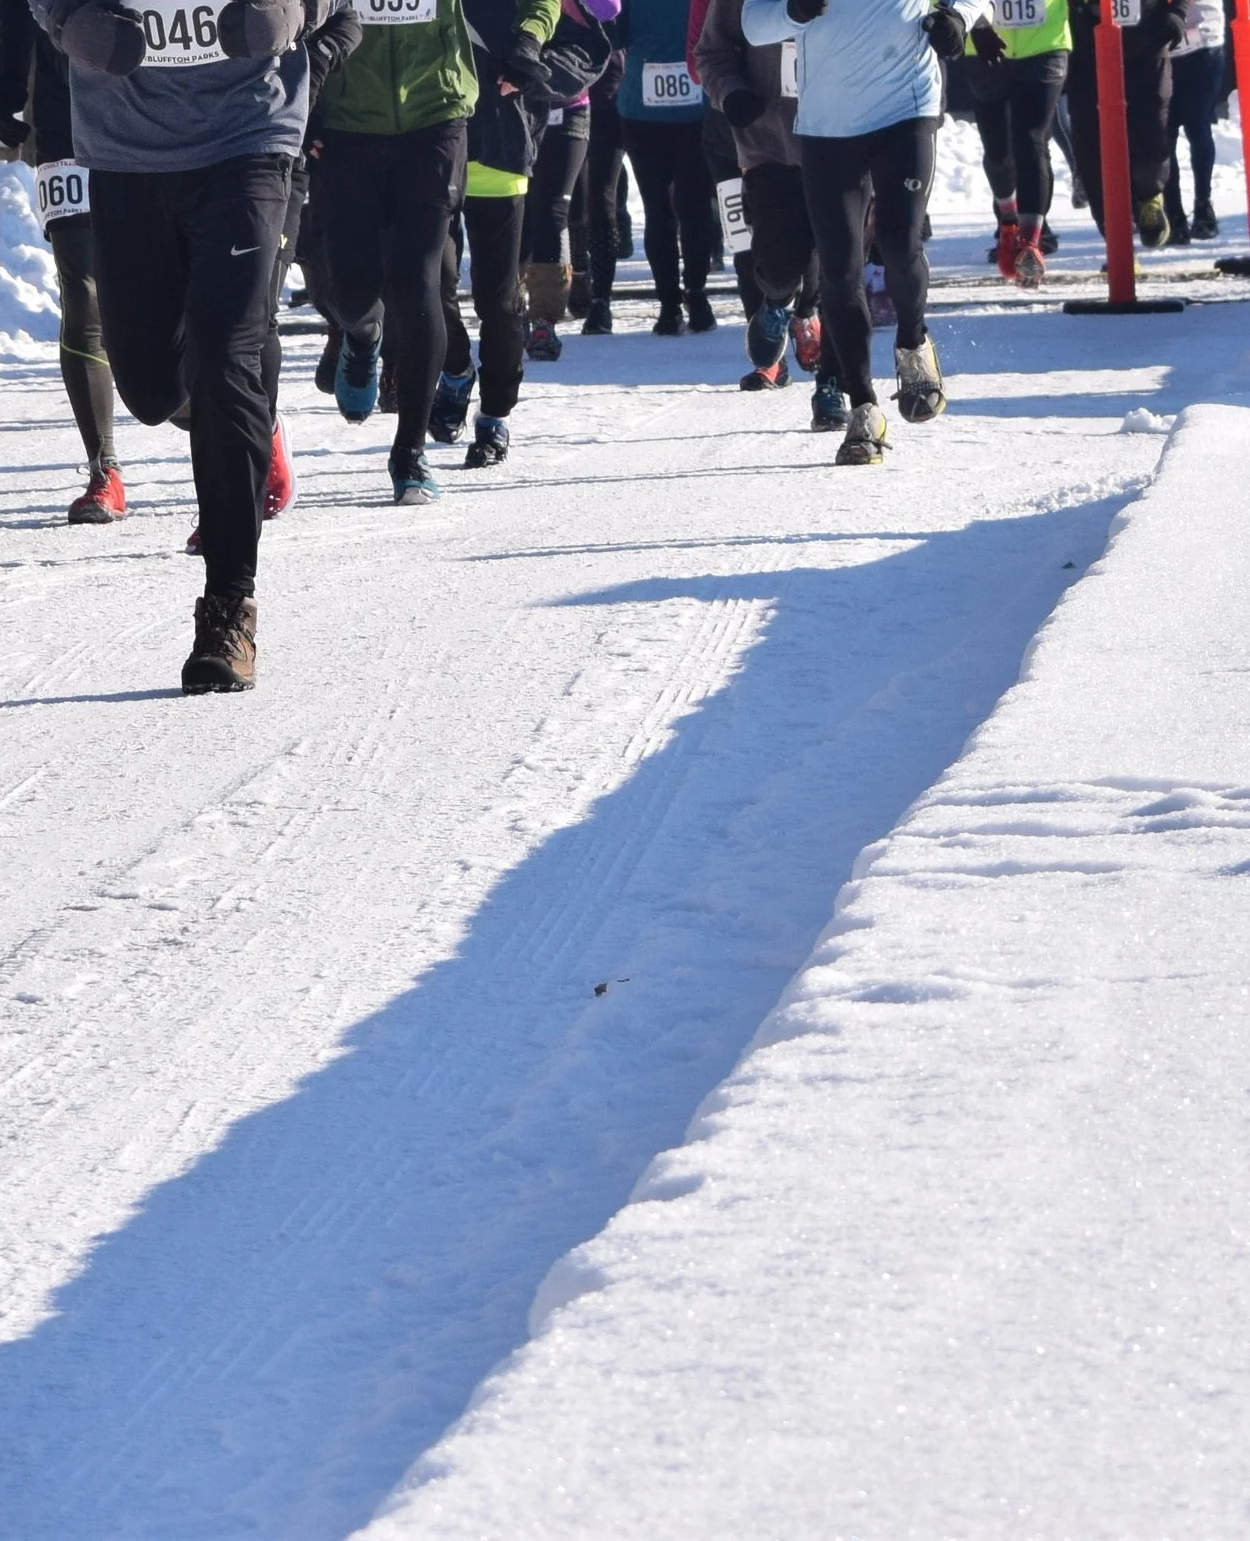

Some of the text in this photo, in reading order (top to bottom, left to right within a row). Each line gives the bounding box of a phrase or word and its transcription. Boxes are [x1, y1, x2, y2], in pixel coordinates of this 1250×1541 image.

[143, 5, 218, 51] 046
[147, 51, 219, 63] BLUFFTON PARKS
[654, 73, 690, 98] 086
[38, 174, 83, 213] 060
